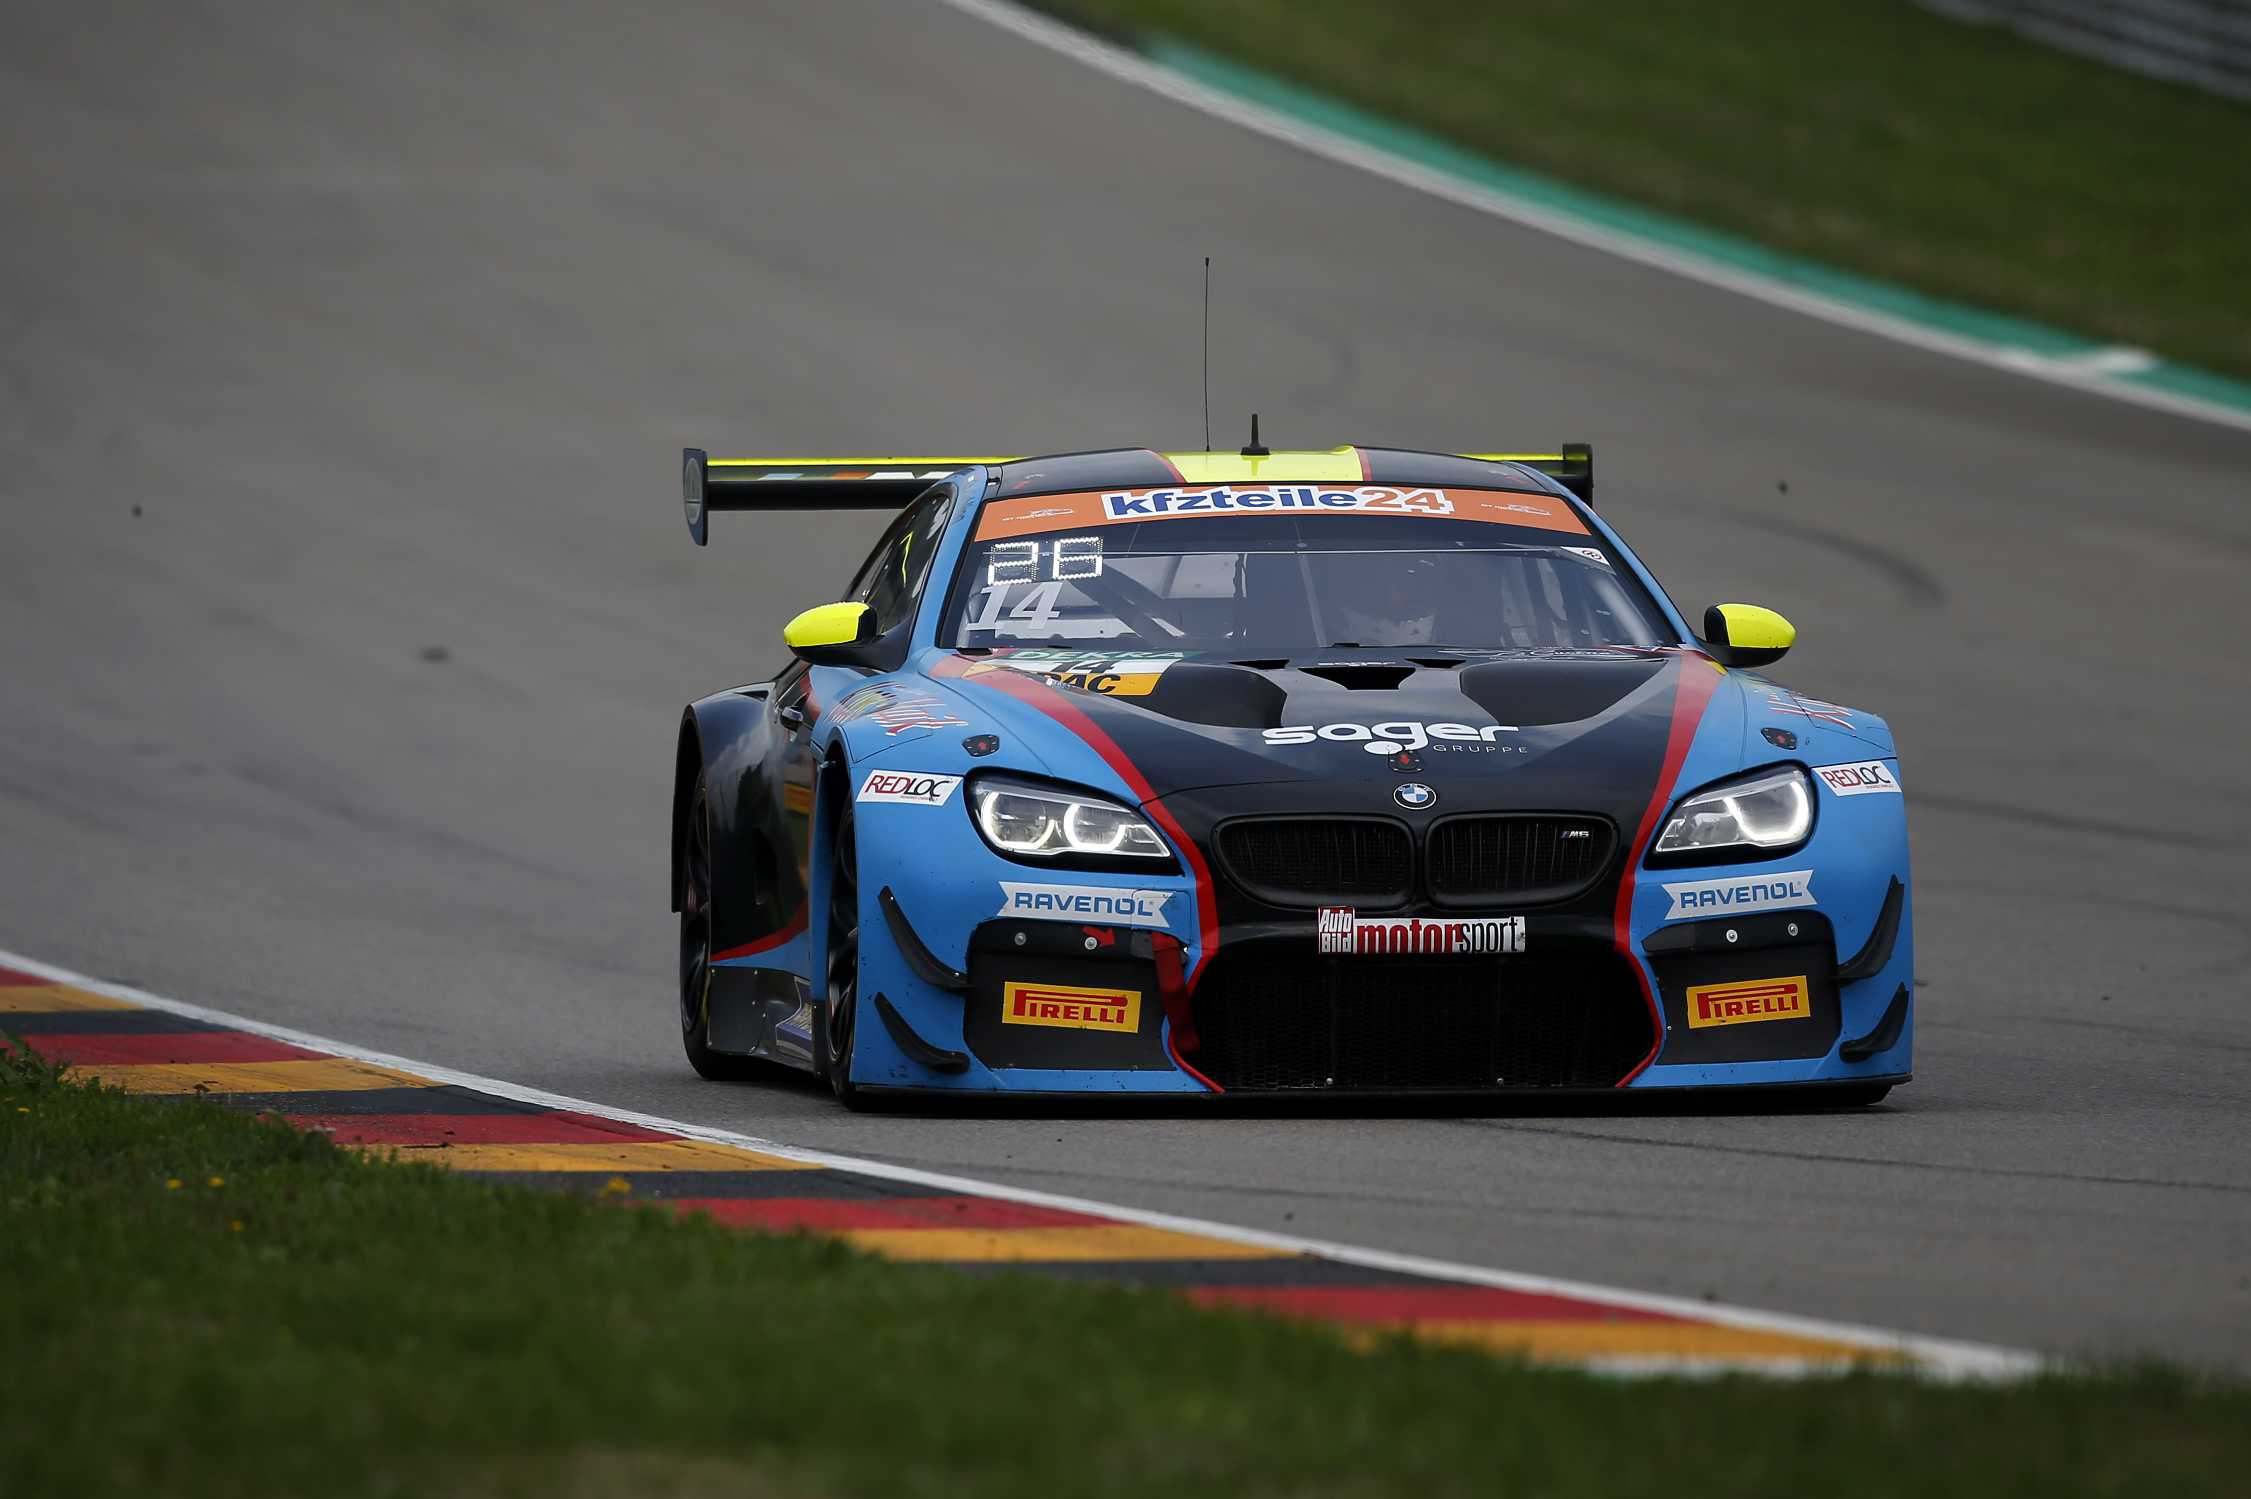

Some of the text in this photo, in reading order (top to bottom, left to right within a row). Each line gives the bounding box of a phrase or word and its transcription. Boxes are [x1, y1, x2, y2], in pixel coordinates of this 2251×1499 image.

[1110, 488, 1446, 516] kfzteile24
[987, 536, 1103, 585] 26
[966, 582, 1064, 631] 14
[1011, 651, 1185, 660] DEKRA
[1262, 721, 1519, 755] sager
[1433, 744, 1529, 753] GRUPPE
[864, 774, 952, 799] REDLOC
[1821, 766, 1891, 788] REDLOC
[1015, 892, 1153, 917] RAVENOL
[1680, 882, 1803, 909] RAVENOL
[1320, 908, 1352, 932] Auto
[1013, 989, 1129, 1024] PIRELLI
[1696, 983, 1799, 1020] PIRELLI
